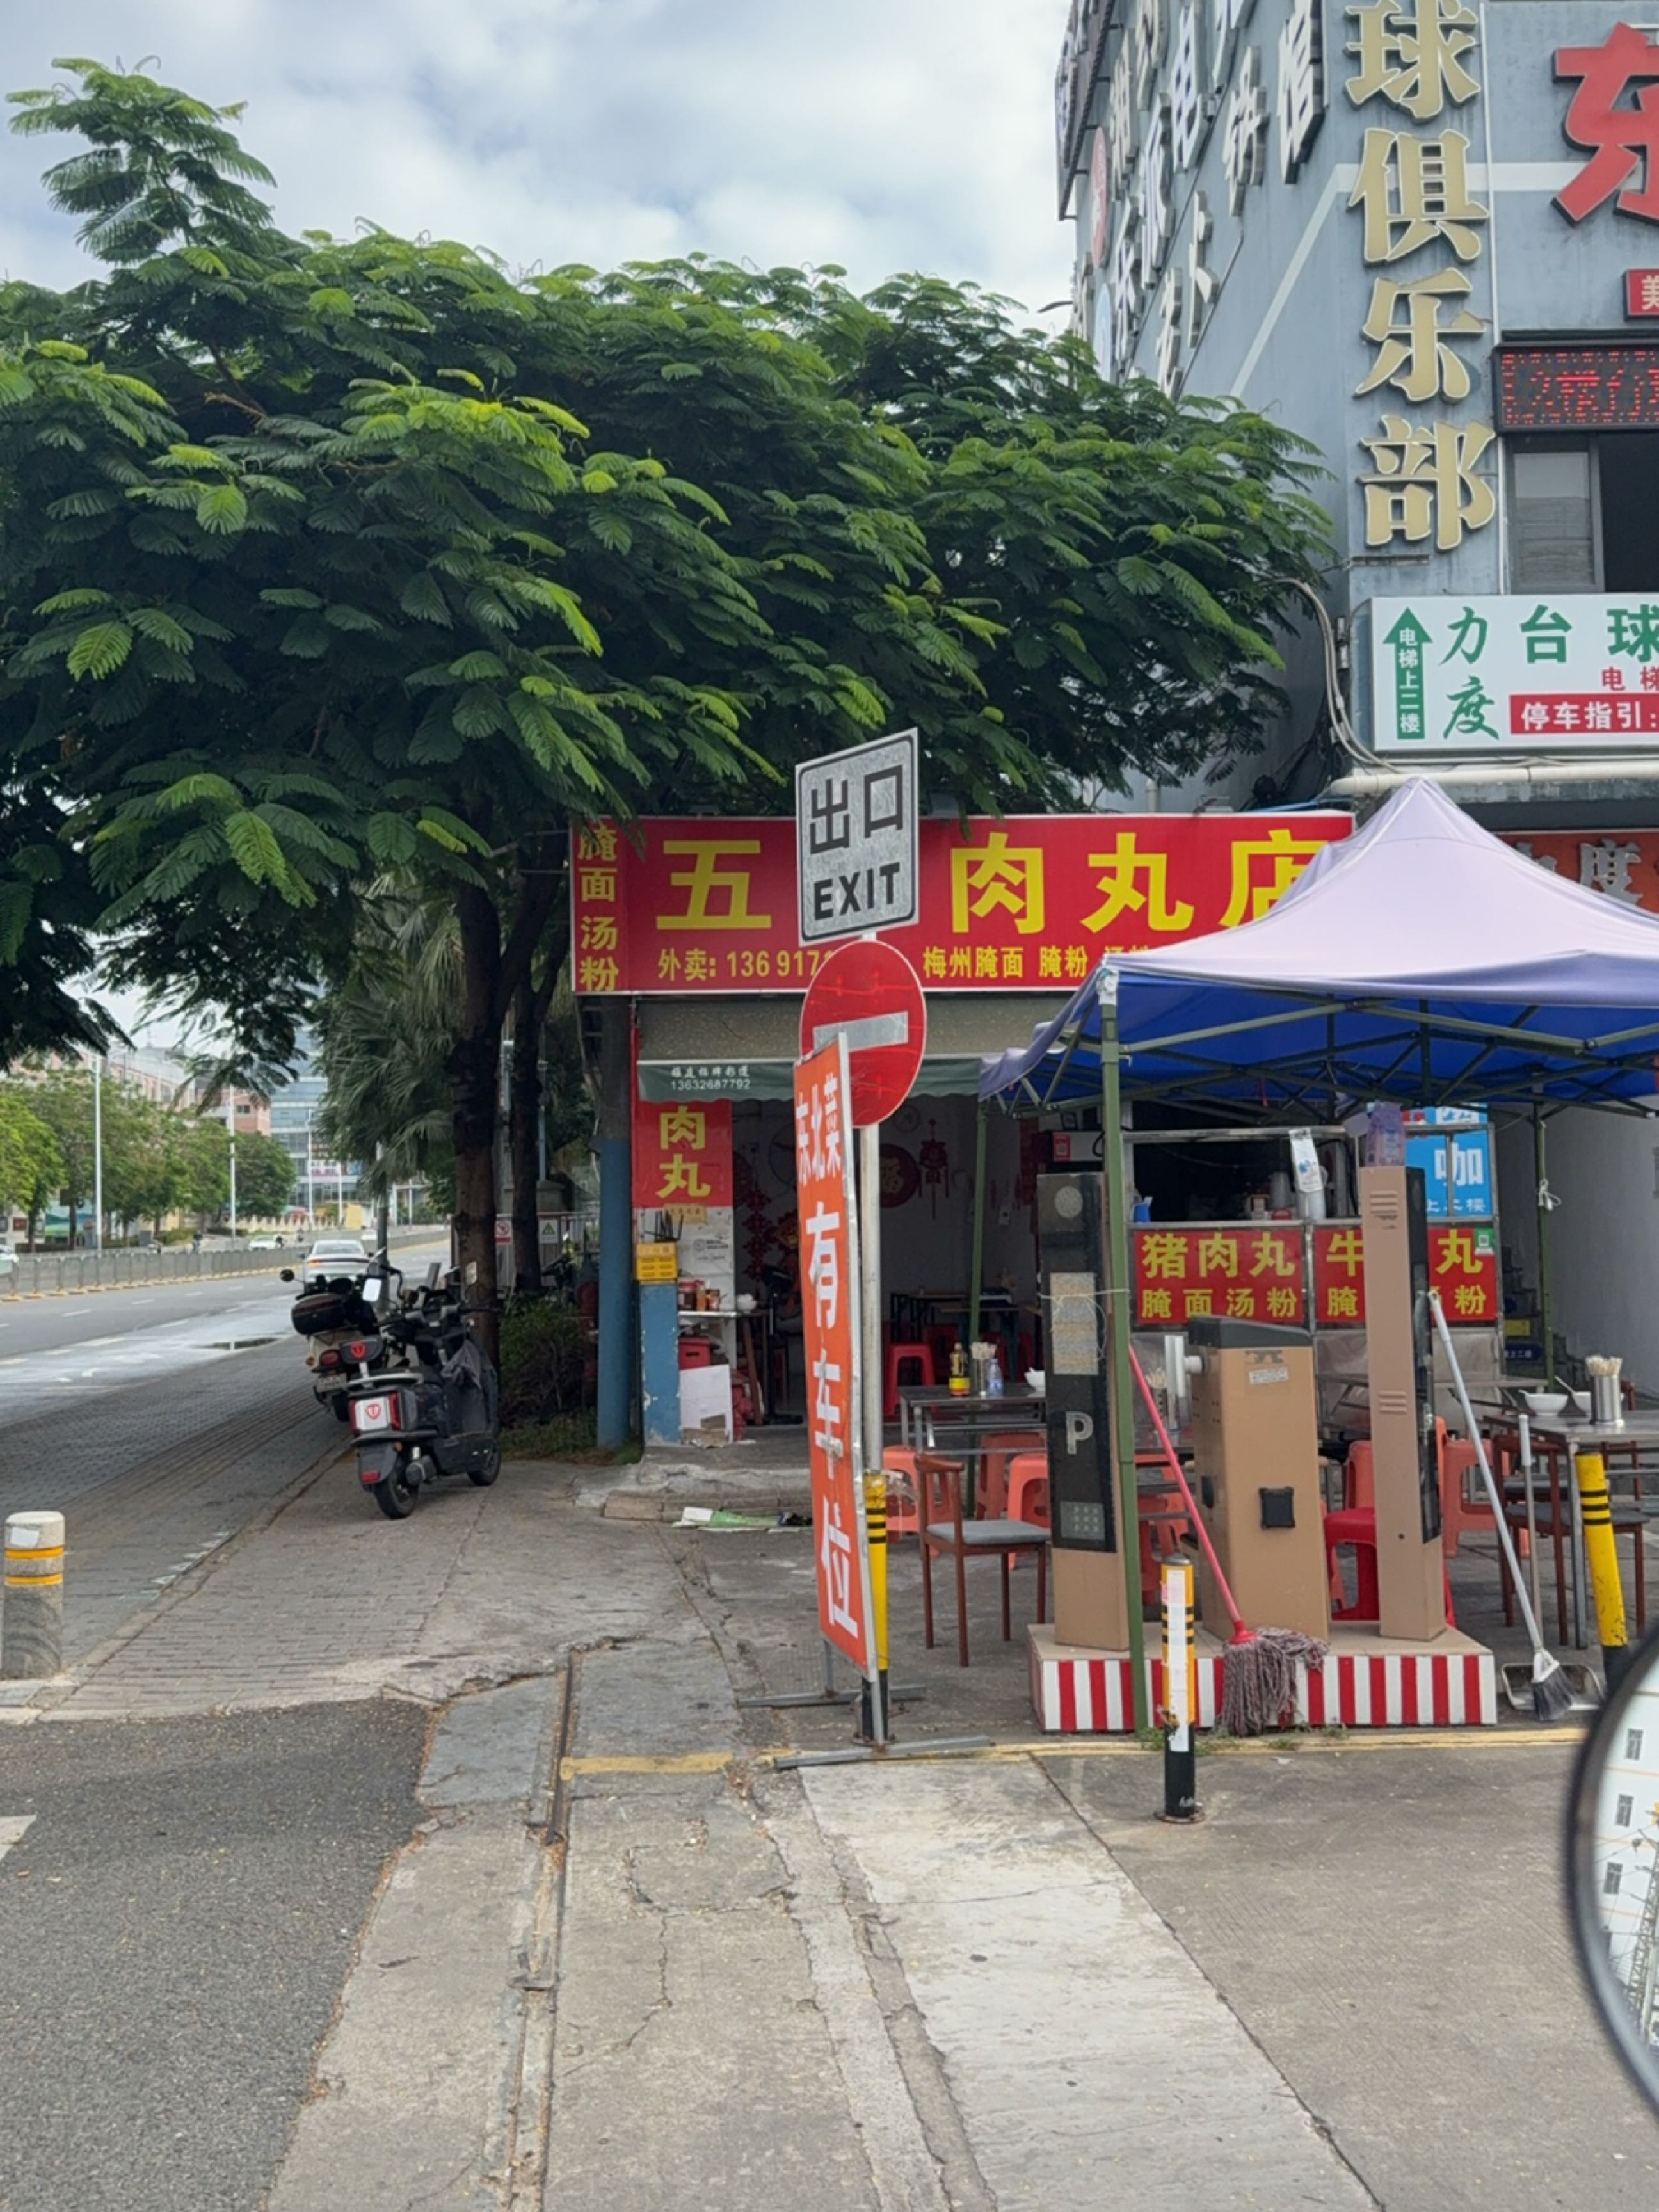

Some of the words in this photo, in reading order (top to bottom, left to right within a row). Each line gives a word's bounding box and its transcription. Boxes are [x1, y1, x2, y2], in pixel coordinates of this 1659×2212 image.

[1345, 0, 1496, 550] 球俱乐部
[1438, 605, 1499, 741] 力度
[1519, 604, 1659, 663] 台球
[1398, 627, 1420, 733] 电梯上二楼
[810, 765, 903, 854] 出口
[656, 830, 1327, 934] 五肉丸店
[813, 862, 900, 921] EXIT
[655, 1105, 711, 1199] 肉丸
[1142, 1231, 1296, 1278] 猪肉丸
[1142, 1286, 1297, 1318] 腌面汤粉
[1065, 1411, 1094, 1455] P
